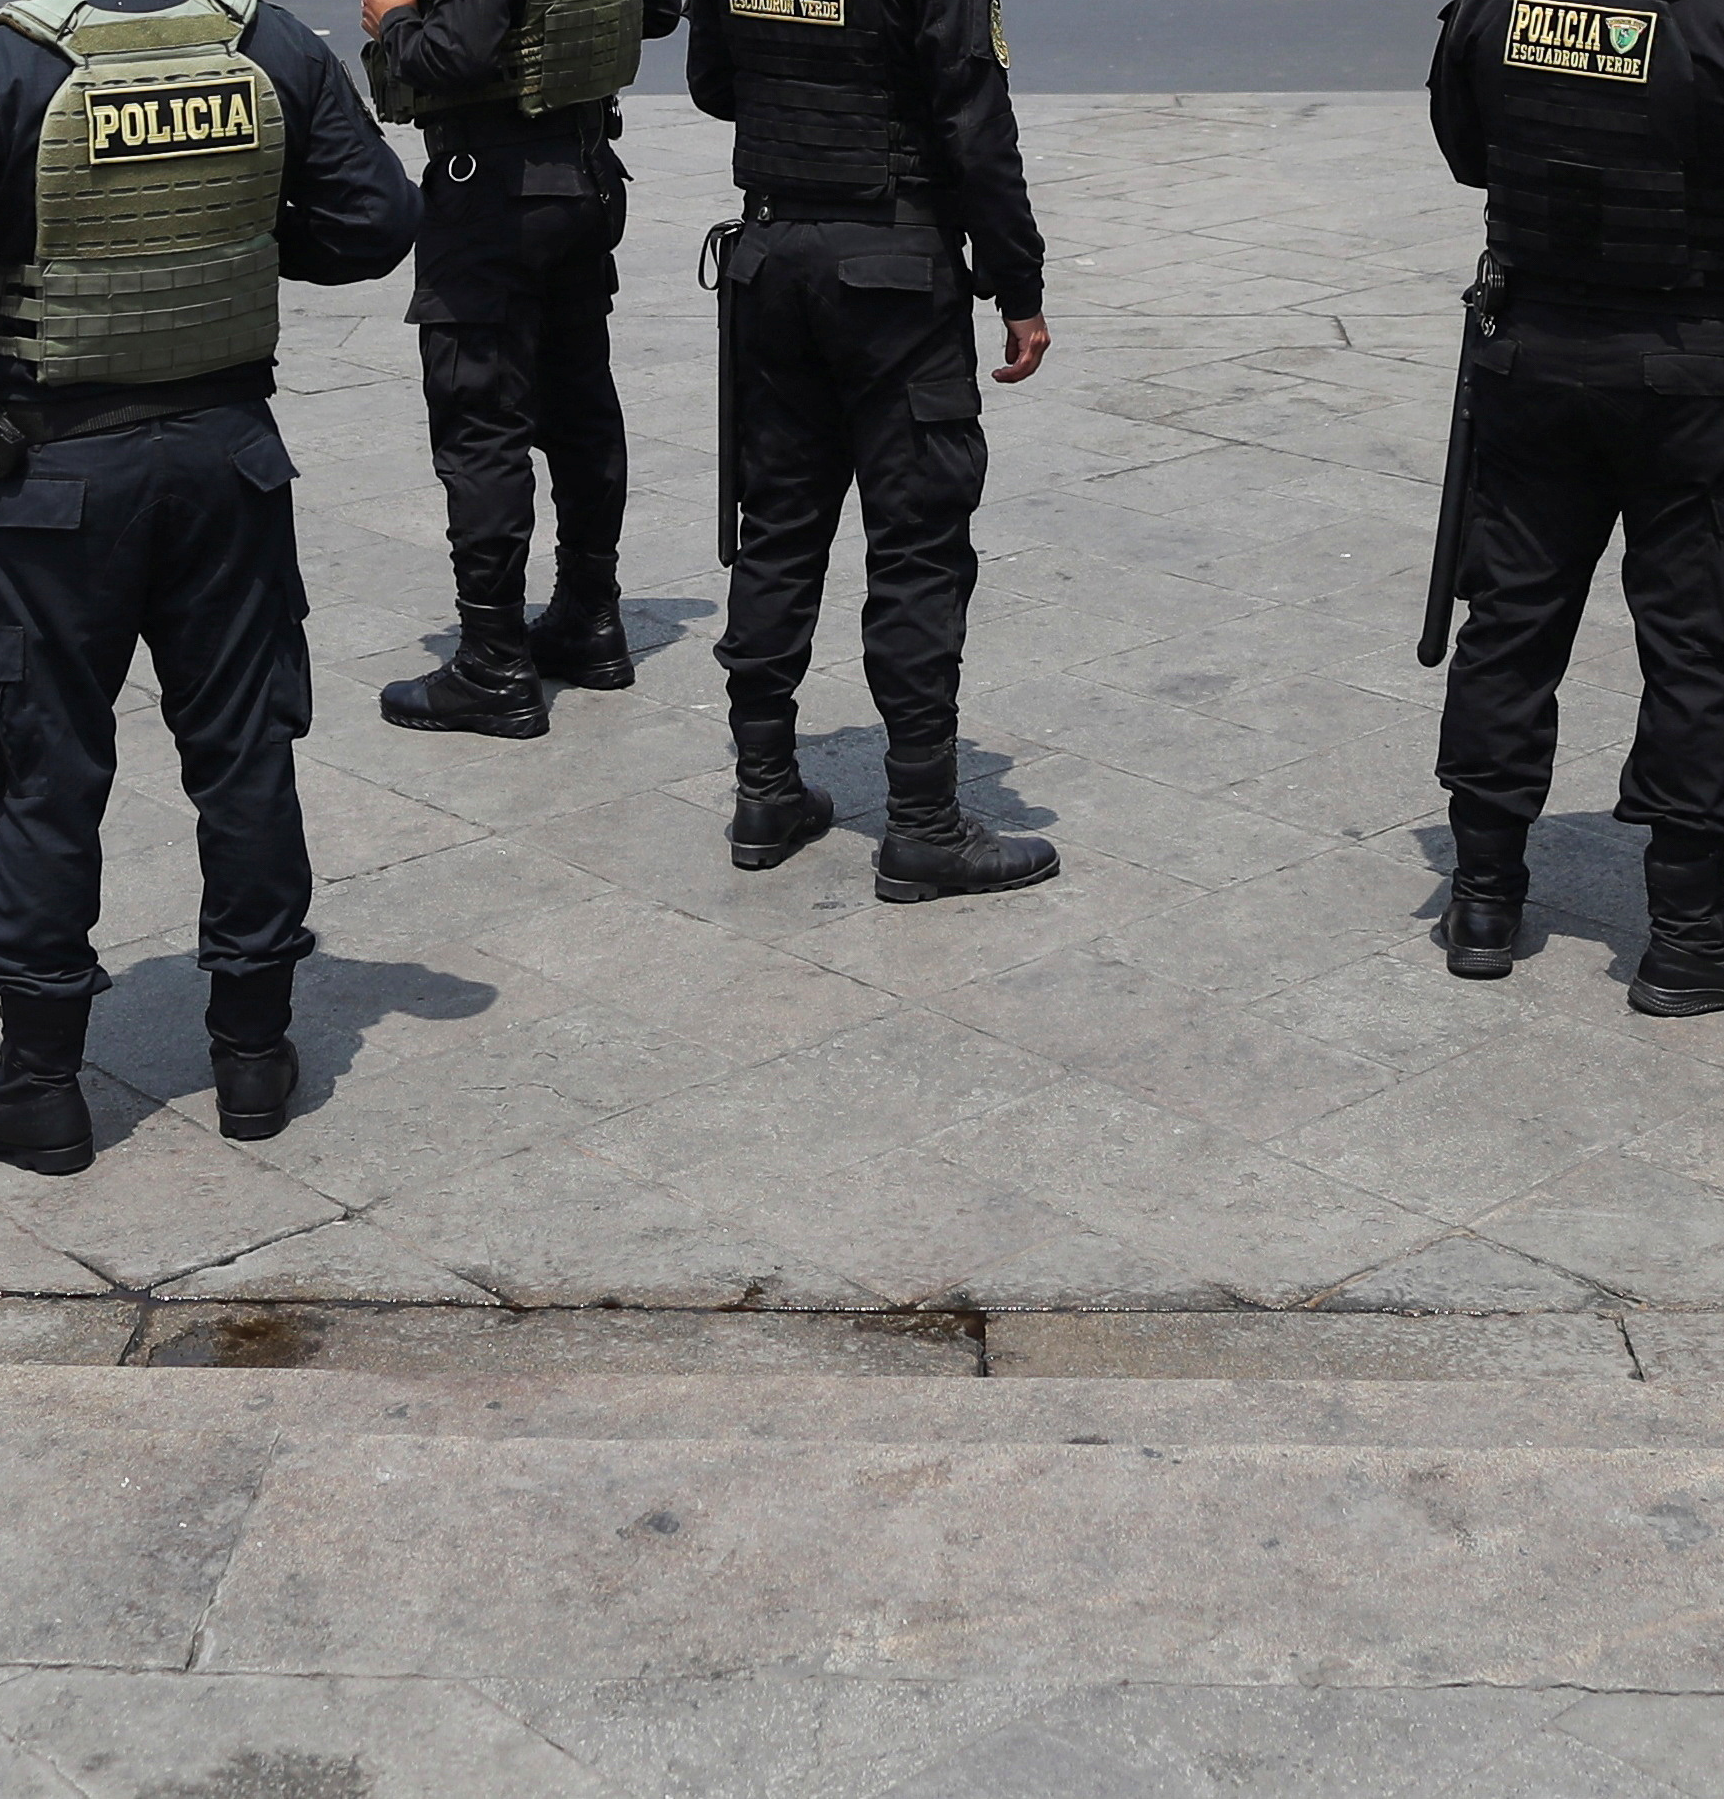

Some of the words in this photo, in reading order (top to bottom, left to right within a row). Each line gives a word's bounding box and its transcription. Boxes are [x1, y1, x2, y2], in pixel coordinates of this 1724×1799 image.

[1512, 3, 1601, 52] POLICIA
[1510, 42, 1590, 71] ESCUADRON
[1595, 54, 1642, 76] VERDE
[92, 92, 254, 149] POLICIA
